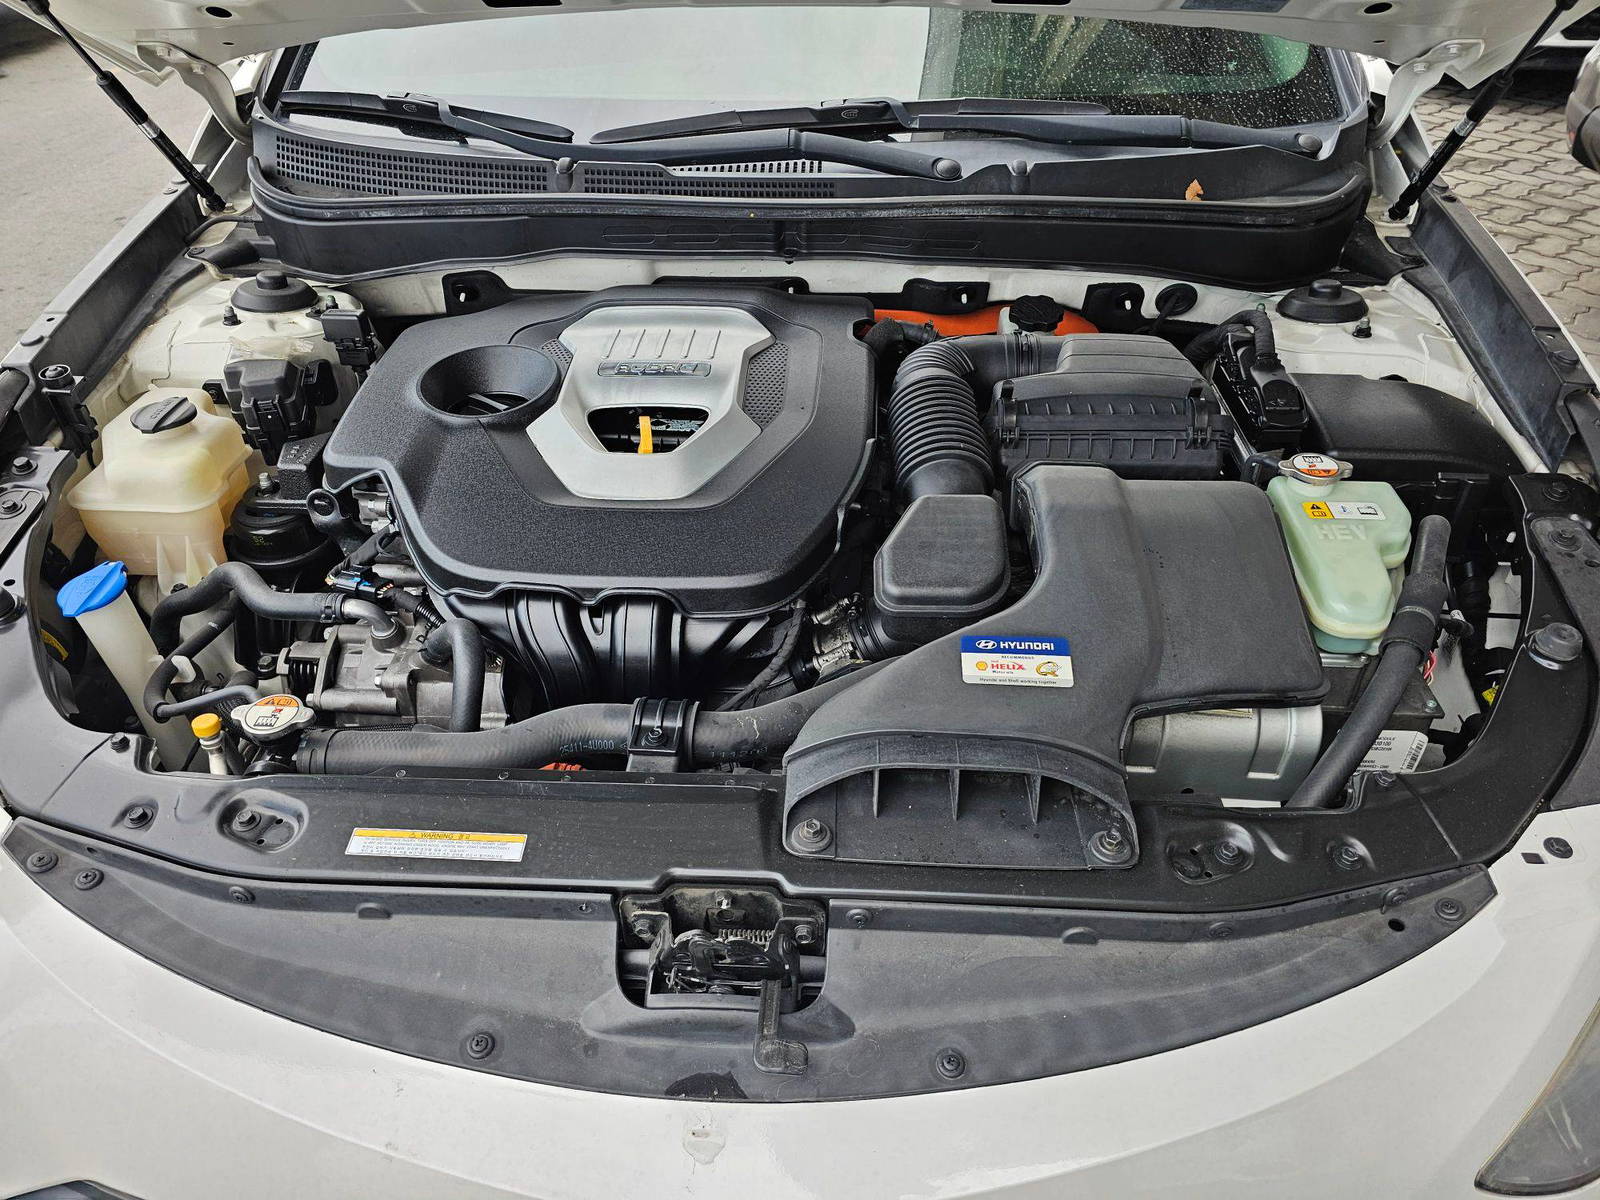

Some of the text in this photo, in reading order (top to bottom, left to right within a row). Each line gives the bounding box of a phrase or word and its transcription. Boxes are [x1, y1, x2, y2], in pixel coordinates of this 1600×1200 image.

[1315, 523, 1368, 540] HEV
[1000, 641, 1055, 651] HYUNDAI
[991, 662, 1026, 671] HELIX
[421, 832, 454, 840] WARNING
